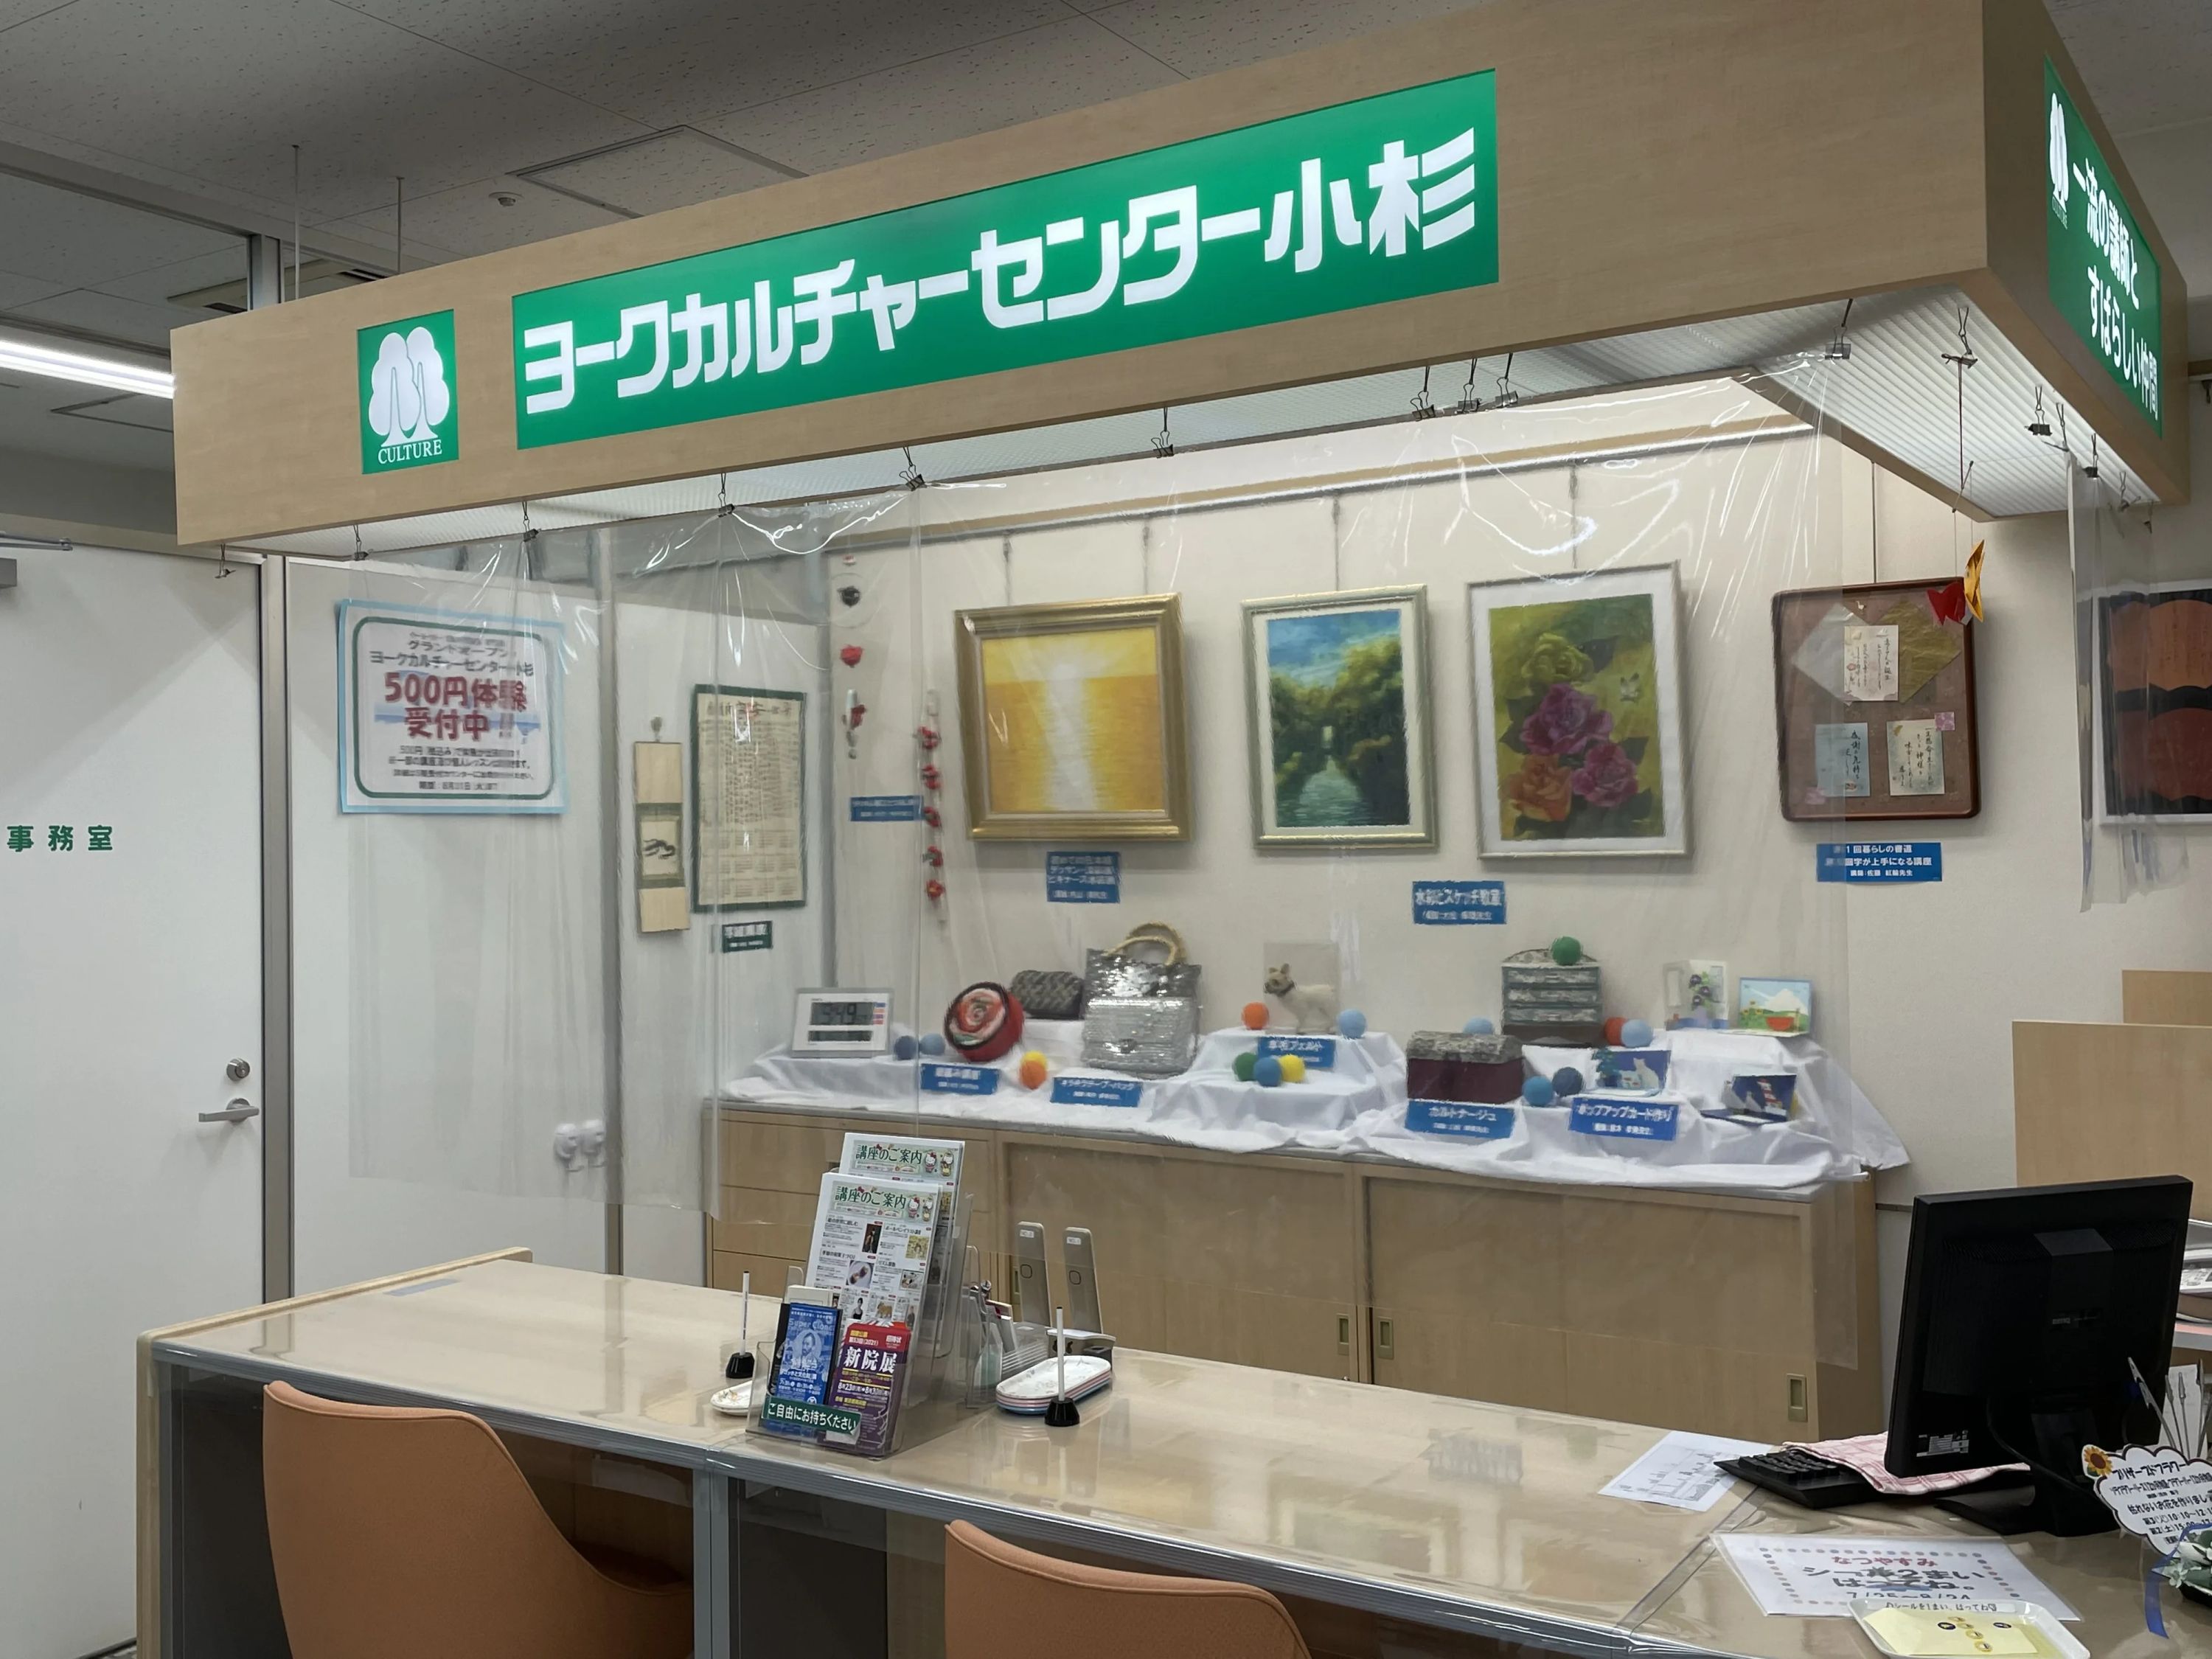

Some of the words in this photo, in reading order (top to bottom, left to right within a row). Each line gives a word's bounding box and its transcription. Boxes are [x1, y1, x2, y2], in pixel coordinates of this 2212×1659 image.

[2073, 157, 2139, 310] 一流の講師と
[524, 127, 1475, 414] ヨークカルチャーセンター小杉
[2087, 264, 2157, 421] すばらしい仲間
[378, 439, 442, 464] CULTURE
[405, 706, 492, 741] 受付中
[7, 825, 113, 852] 事務室
[856, 1144, 922, 1164] 講座のご案内
[835, 1186, 907, 1209] 講座のご案内
[844, 1346, 897, 1374] 新院展
[768, 1403, 857, 1431] ご自由にお持ちください
[1832, 1556, 1938, 1567] なつやすみ
